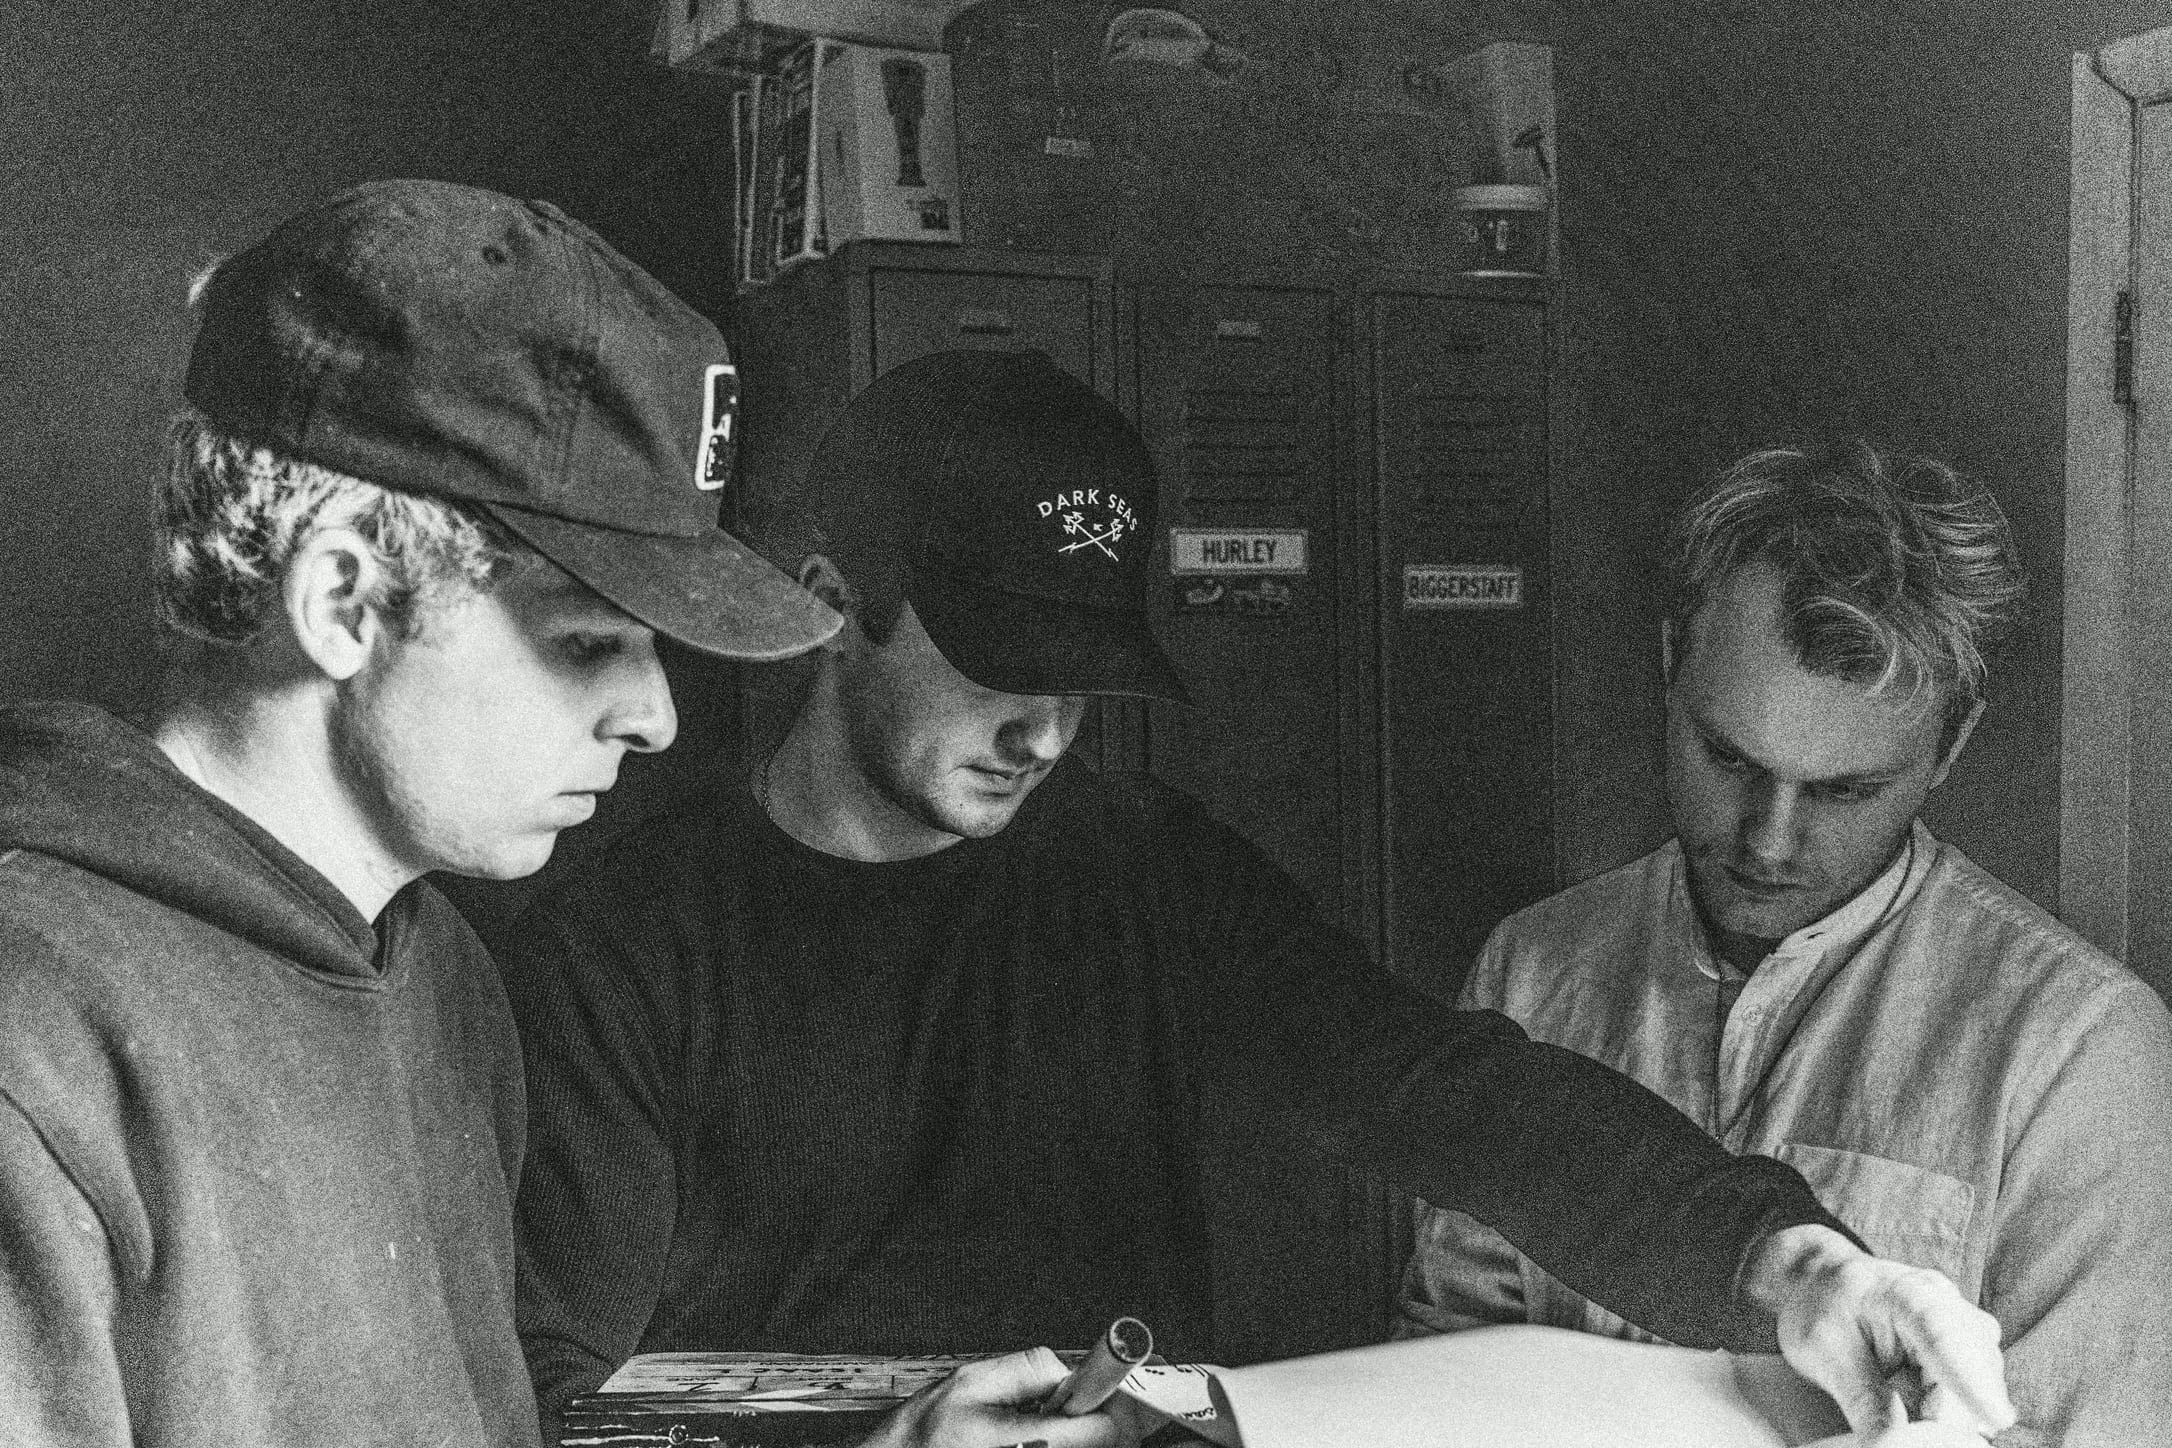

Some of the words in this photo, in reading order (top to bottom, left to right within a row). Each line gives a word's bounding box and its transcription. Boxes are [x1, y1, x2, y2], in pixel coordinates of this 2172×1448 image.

[1037, 488, 1100, 518] DARK
[1108, 494, 1137, 531] SEAS
[1202, 539, 1276, 563] HURLEY
[1407, 575, 1517, 599] BIGGERSTAFF
